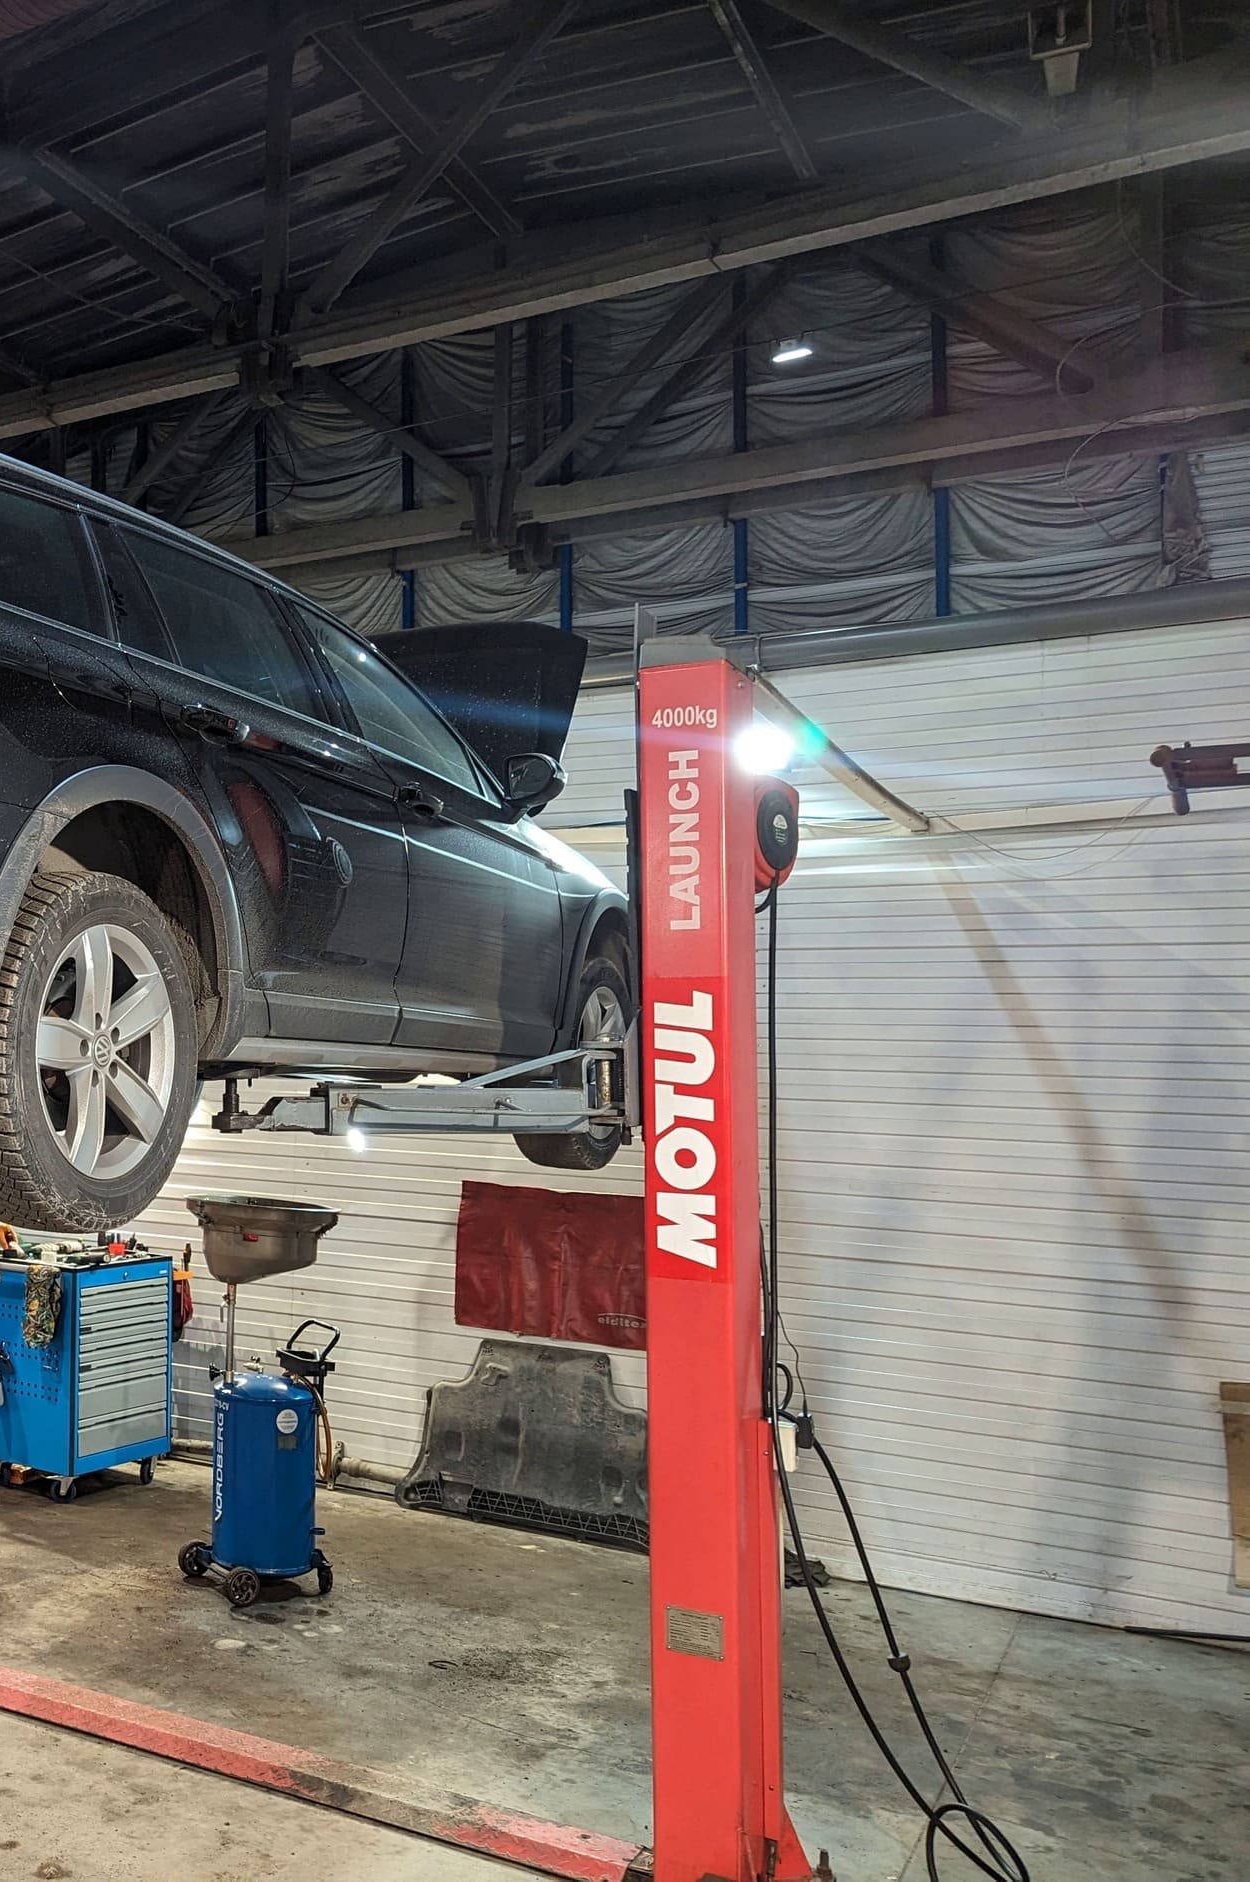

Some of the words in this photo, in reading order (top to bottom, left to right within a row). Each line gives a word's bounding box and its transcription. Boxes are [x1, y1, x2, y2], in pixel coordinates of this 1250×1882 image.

[652, 705, 717, 729] 4000kg
[668, 749, 700, 930] LAUNCH
[654, 990, 717, 1269] MOTUL
